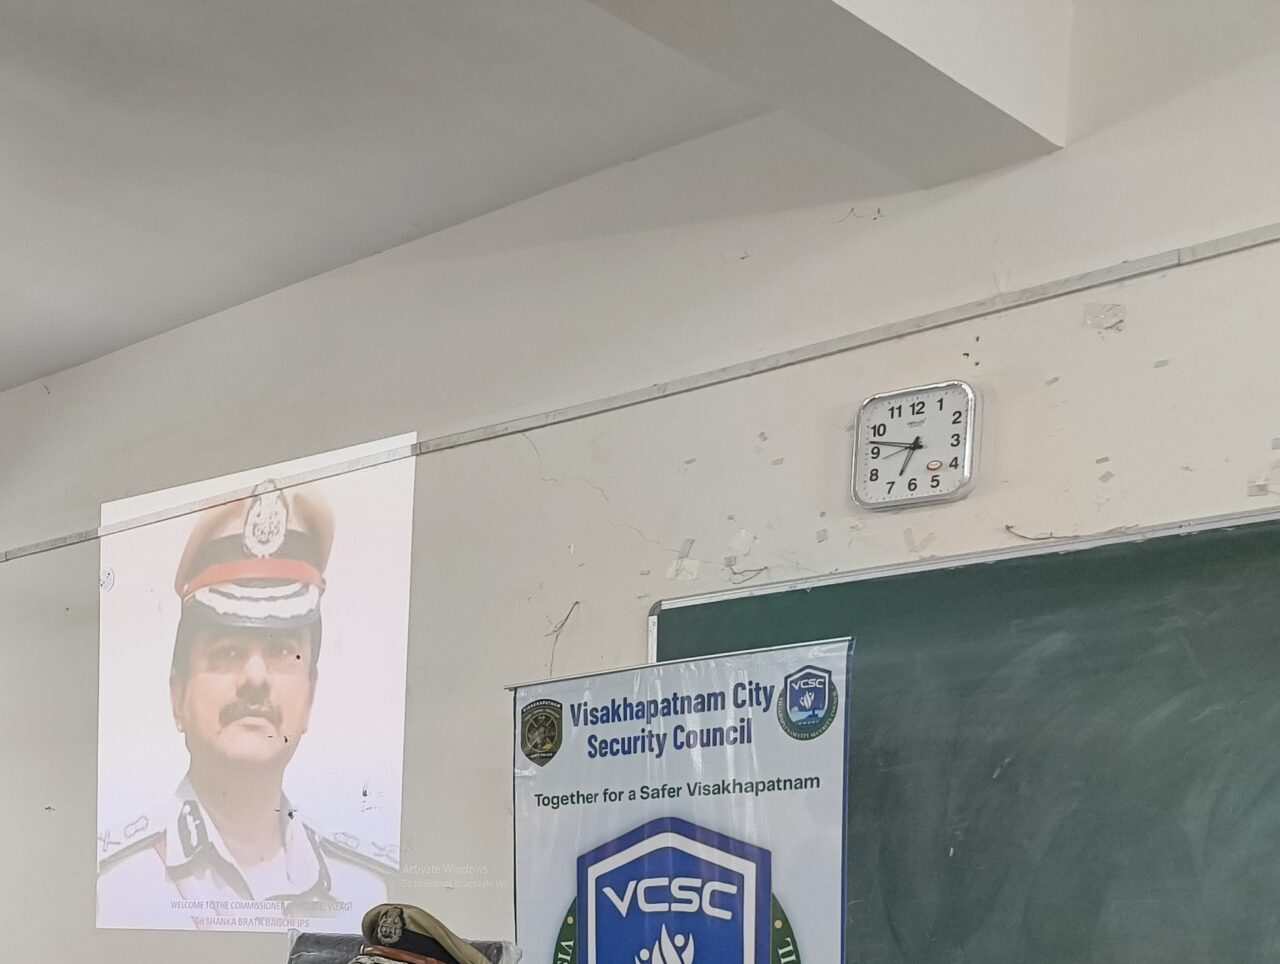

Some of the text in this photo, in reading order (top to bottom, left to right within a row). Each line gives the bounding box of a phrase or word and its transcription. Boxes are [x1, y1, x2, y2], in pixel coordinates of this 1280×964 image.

[909, 401, 925, 416] 12
[937, 398, 944, 411] 1
[888, 405, 902, 419] 11
[952, 411, 962, 424] 2
[870, 423, 887, 437] 10
[950, 433, 960, 447] 3
[870, 446, 880, 459] 9
[949, 456, 959, 470] 4
[869, 468, 879, 482] 8
[930, 475, 940, 488] 5
[885, 481, 895, 494] 7
[907, 478, 918, 492] 6
[791, 678, 824, 690] VCSC
[570, 681, 775, 727] Visakhapatnam City
[587, 717, 752, 759] Security Council
[534, 776, 820, 810] Together for a Safer Visakhapatnam
[603, 876, 738, 920] VCSC
[171, 901, 204, 909] WELCOME
[205, 901, 216, 909] TO
[216, 901, 229, 909] THE
[231, 901, 285, 910] COMMISSIONER
[206, 917, 236, 926] SHANKA
[265, 917, 295, 928] BAGCHI
[297, 918, 310, 928] IPS
